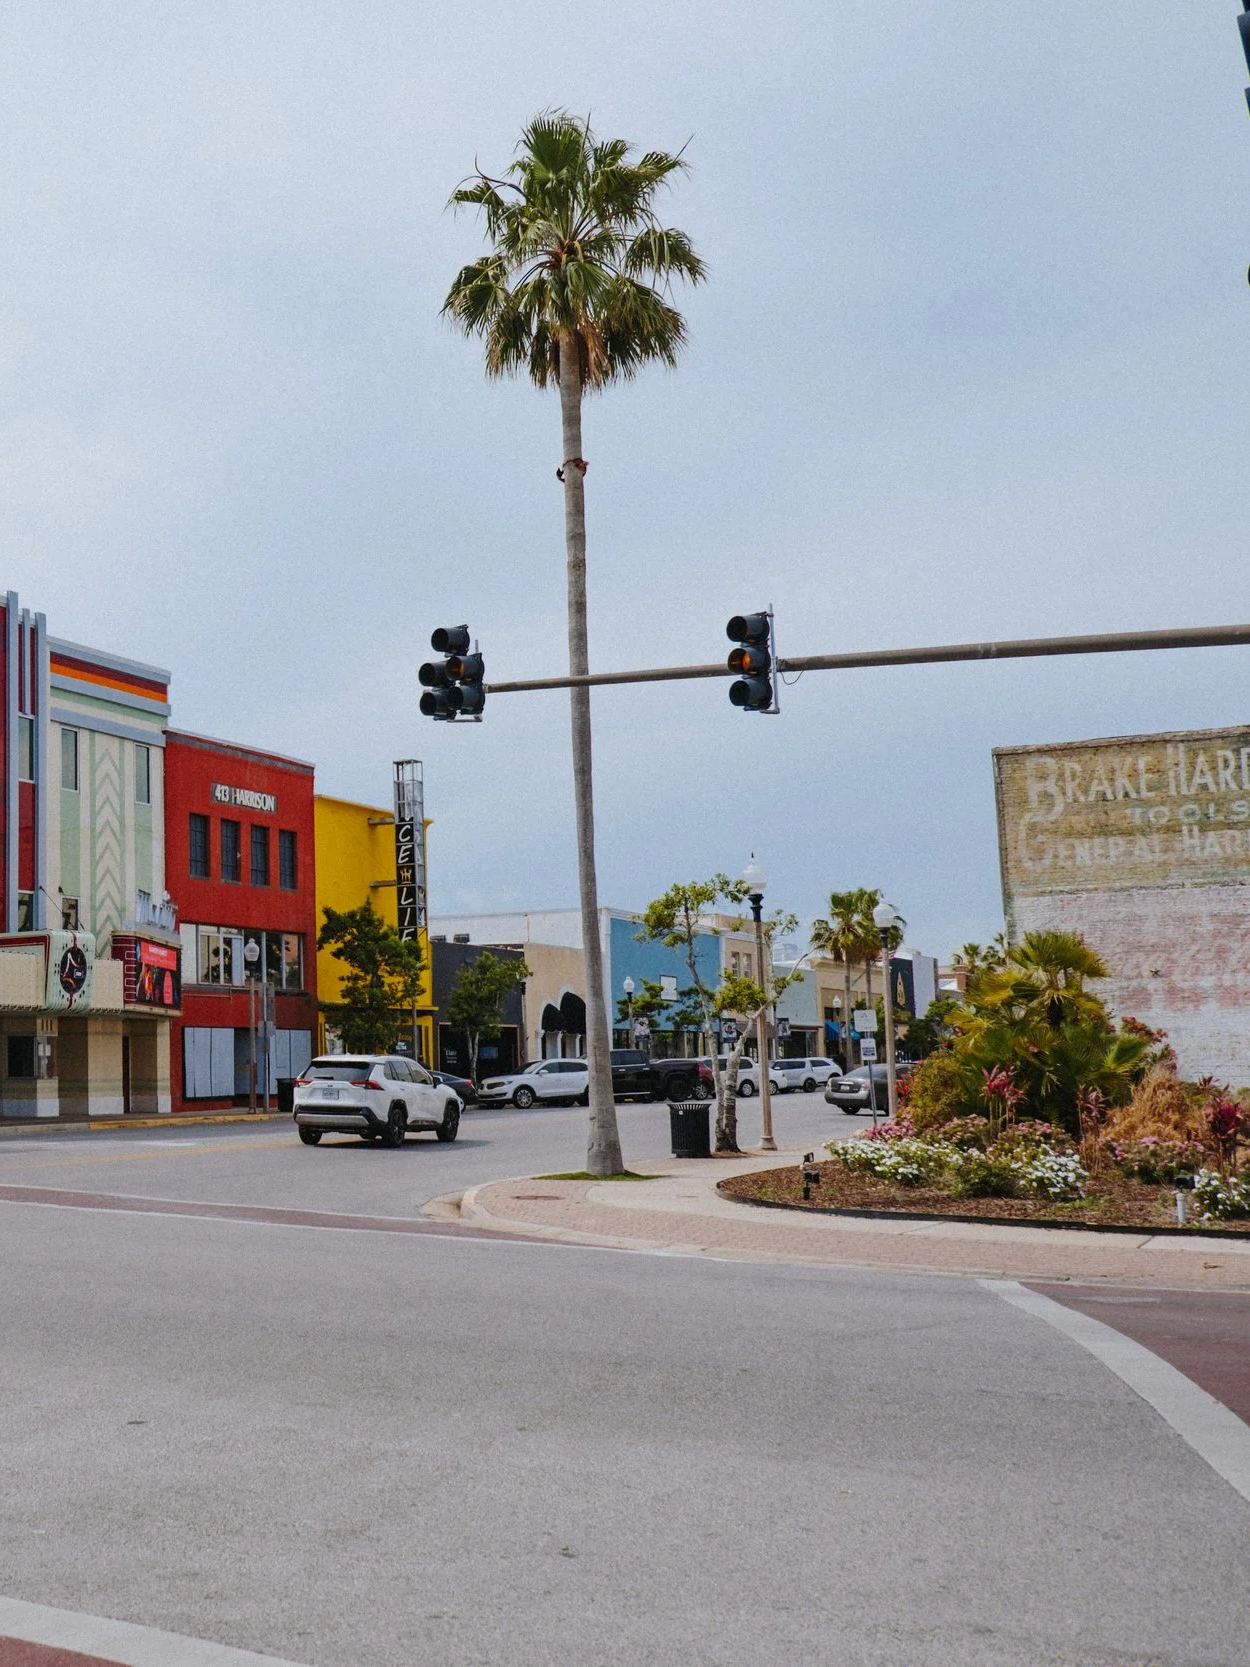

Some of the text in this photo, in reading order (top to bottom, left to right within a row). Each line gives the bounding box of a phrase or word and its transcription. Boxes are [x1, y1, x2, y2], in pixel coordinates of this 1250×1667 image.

[215, 784, 275, 812] 413 HARRISON
[1026, 755, 1157, 822] BRAKE
[1126, 800, 1250, 825] TOOLS
